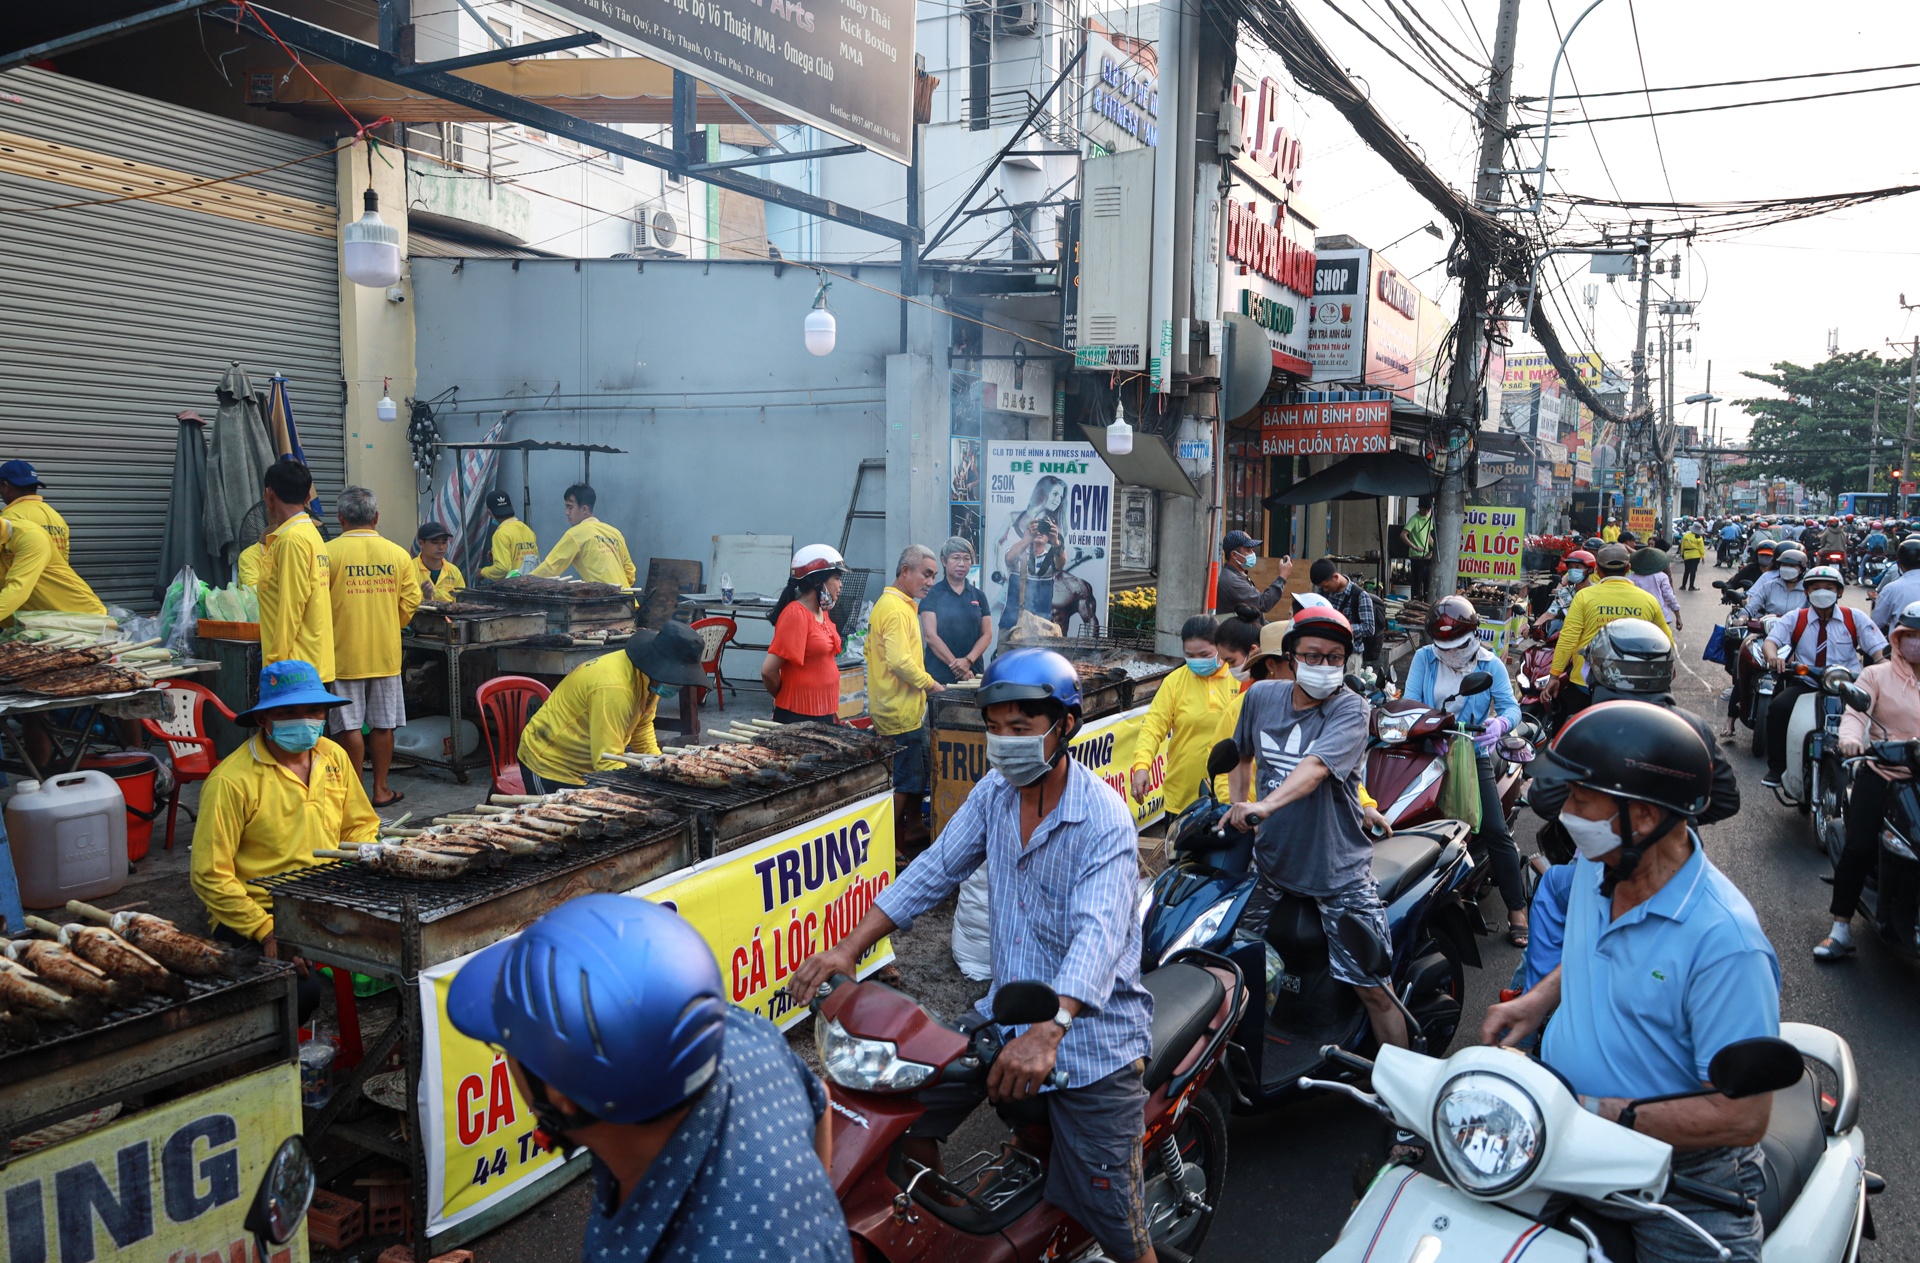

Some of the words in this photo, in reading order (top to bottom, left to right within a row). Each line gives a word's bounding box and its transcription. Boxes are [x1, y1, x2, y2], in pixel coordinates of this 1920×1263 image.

[840, 0, 868, 19] uay
[869, 5, 891, 31] Thái
[615, 6, 631, 24] Tân
[653, 23, 660, 36] P.
[662, 28, 676, 46] Tây
[703, 46, 713, 60] Q.
[713, 51, 727, 67] Tân
[744, 64, 756, 80] TP.
[756, 69, 774, 88] HCM
[708, 4, 721, 27] Võ
[723, 10, 751, 45] Thuật
[753, 26, 776, 54] MMA
[784, 41, 814, 75] Omega
[815, 57, 834, 82] Club
[840, 15, 863, 40] Kick
[864, 29, 898, 63] Boxing
[839, 42, 864, 67] MMA
[1315, 268, 1349, 292] SHOP
[1272, 311, 1294, 336] FOOD
[1263, 406, 1299, 426] BÁNH
[1302, 405, 1318, 424] MÌ
[1321, 404, 1351, 424] BÌNH
[1355, 406, 1388, 426] ĐỊNH
[992, 448, 1004, 456] CLB
[1006, 448, 1014, 456] TD
[1045, 449, 1051, 457] &
[1052, 449, 1079, 458] FITNESS
[1080, 450, 1097, 459] NAM
[1262, 435, 1295, 455] BÁNH
[1335, 433, 1359, 452] TÂY
[1362, 434, 1387, 452] SƠN
[991, 474, 1015, 491] 250K
[996, 494, 1015, 505] Tháng
[1070, 483, 1109, 532] GYM
[1632, 508, 1653, 516] TRUNG
[1491, 512, 1517, 530] BỤI
[1460, 530, 1478, 553] Á
[1482, 531, 1520, 556] LÓC
[1458, 557, 1490, 575] ƯỚNG
[1493, 559, 1517, 576] MÍA
[346, 578, 357, 587] CÁ
[358, 577, 372, 586] LÓC
[1597, 605, 1642, 617] TRUNG
[938, 740, 991, 784] TRU
[754, 819, 871, 913] TRUNG
[732, 924, 768, 1003] CÁ
[773, 906, 817, 982] LÓC
[457, 1053, 516, 1146] CÁ
[471, 1147, 508, 1186] 44
